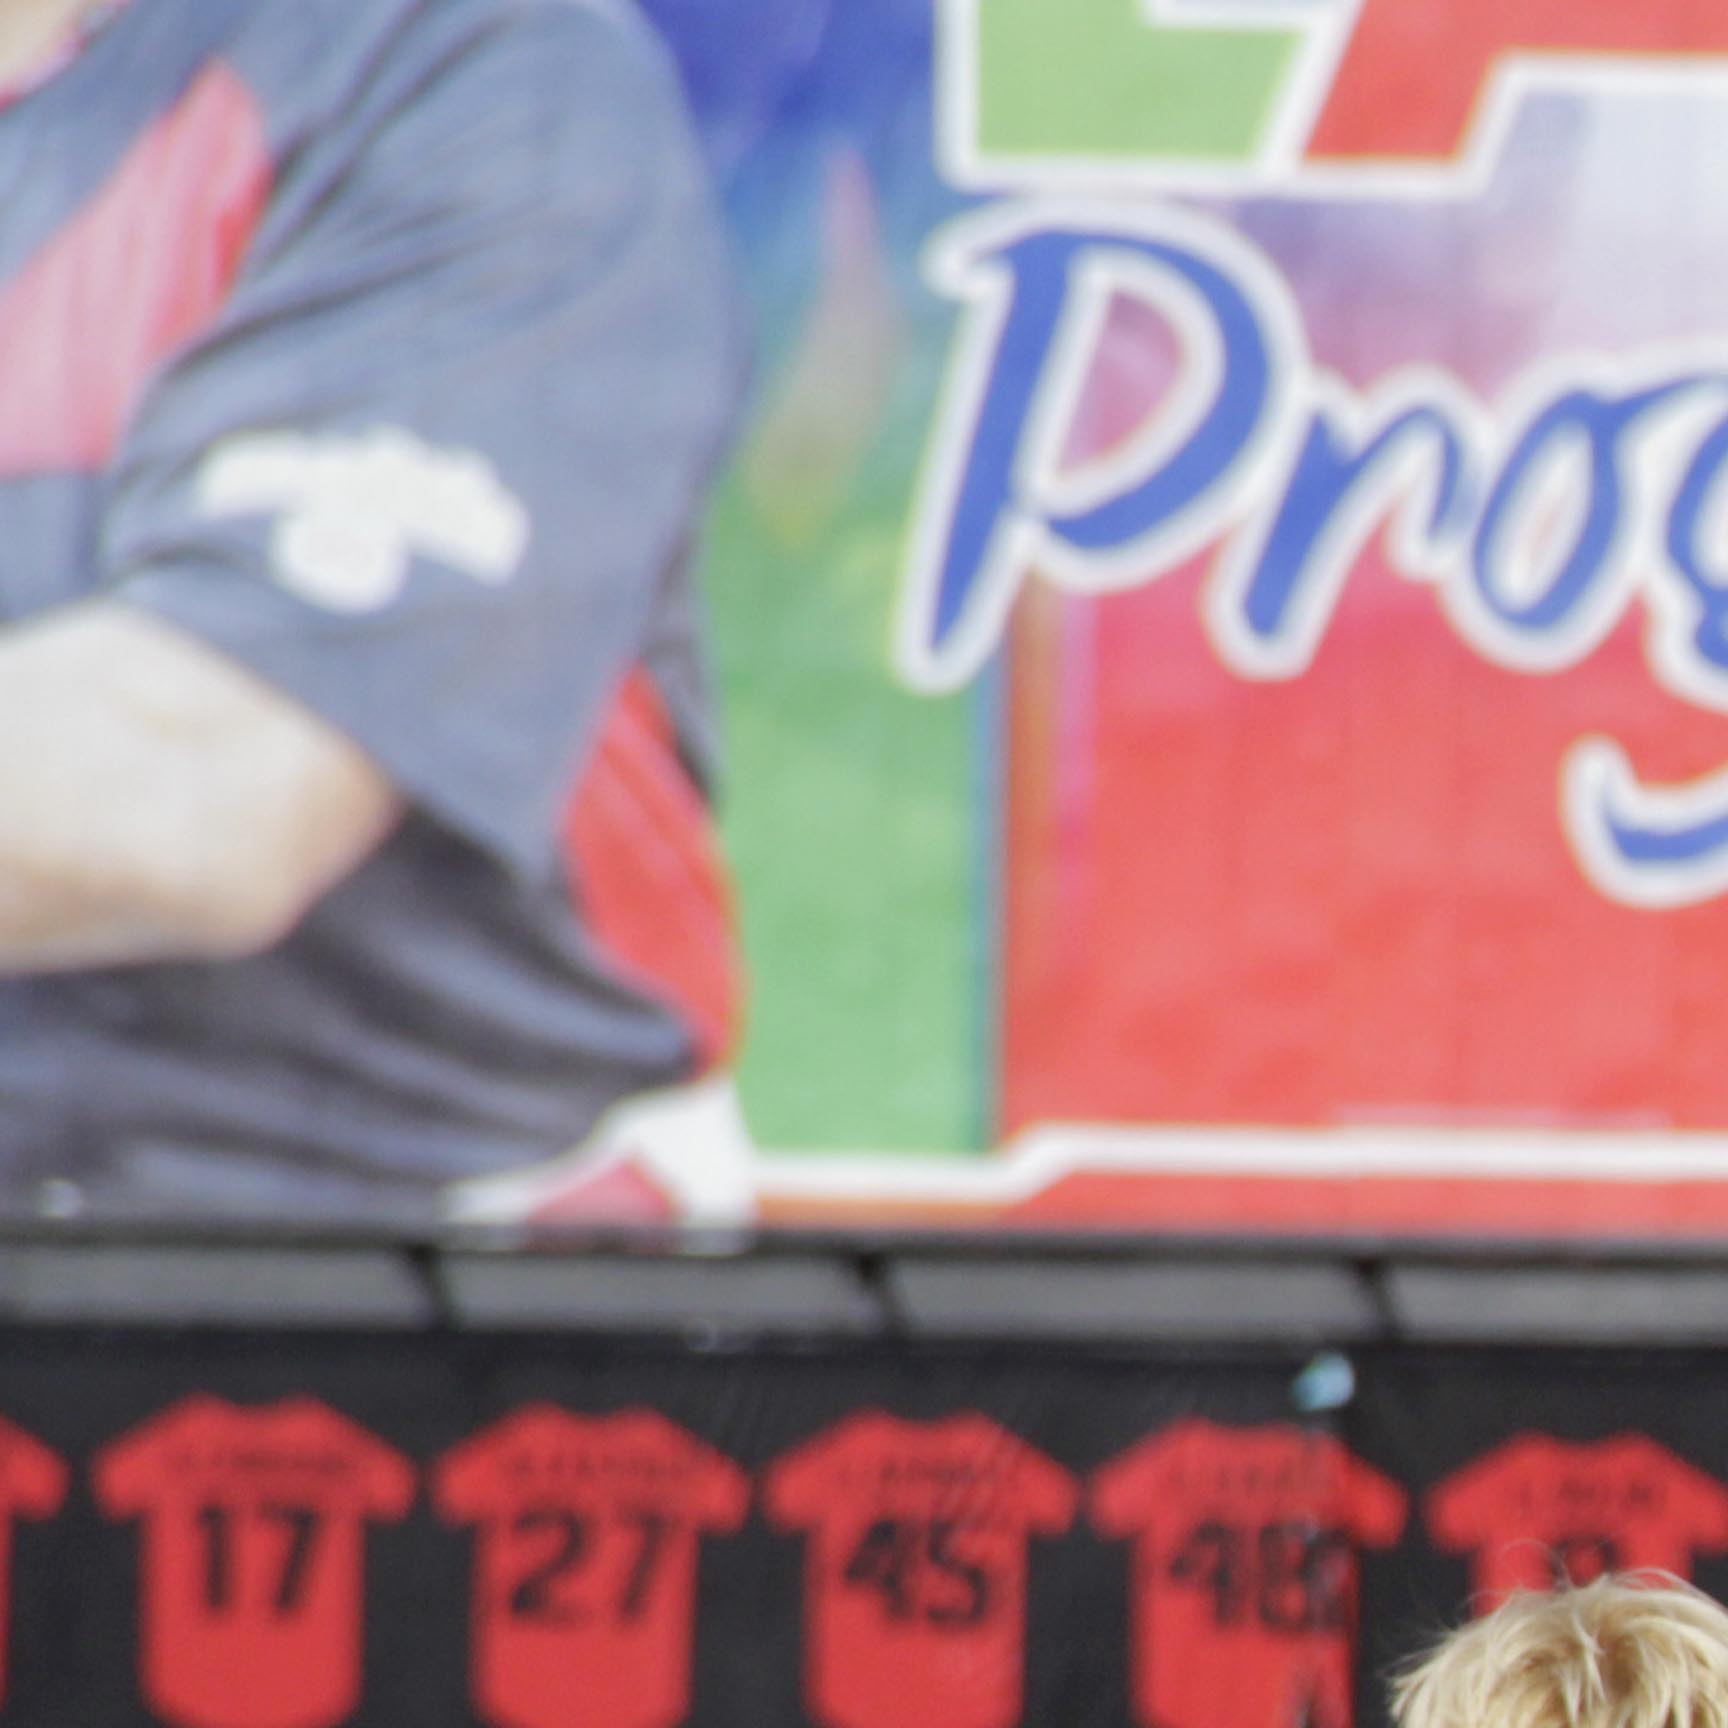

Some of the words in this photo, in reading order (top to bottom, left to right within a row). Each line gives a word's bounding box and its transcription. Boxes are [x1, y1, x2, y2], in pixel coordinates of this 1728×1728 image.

[196, 1502, 326, 1617] 17
[510, 1505, 678, 1623] 27
[844, 1516, 1000, 1628] 45
